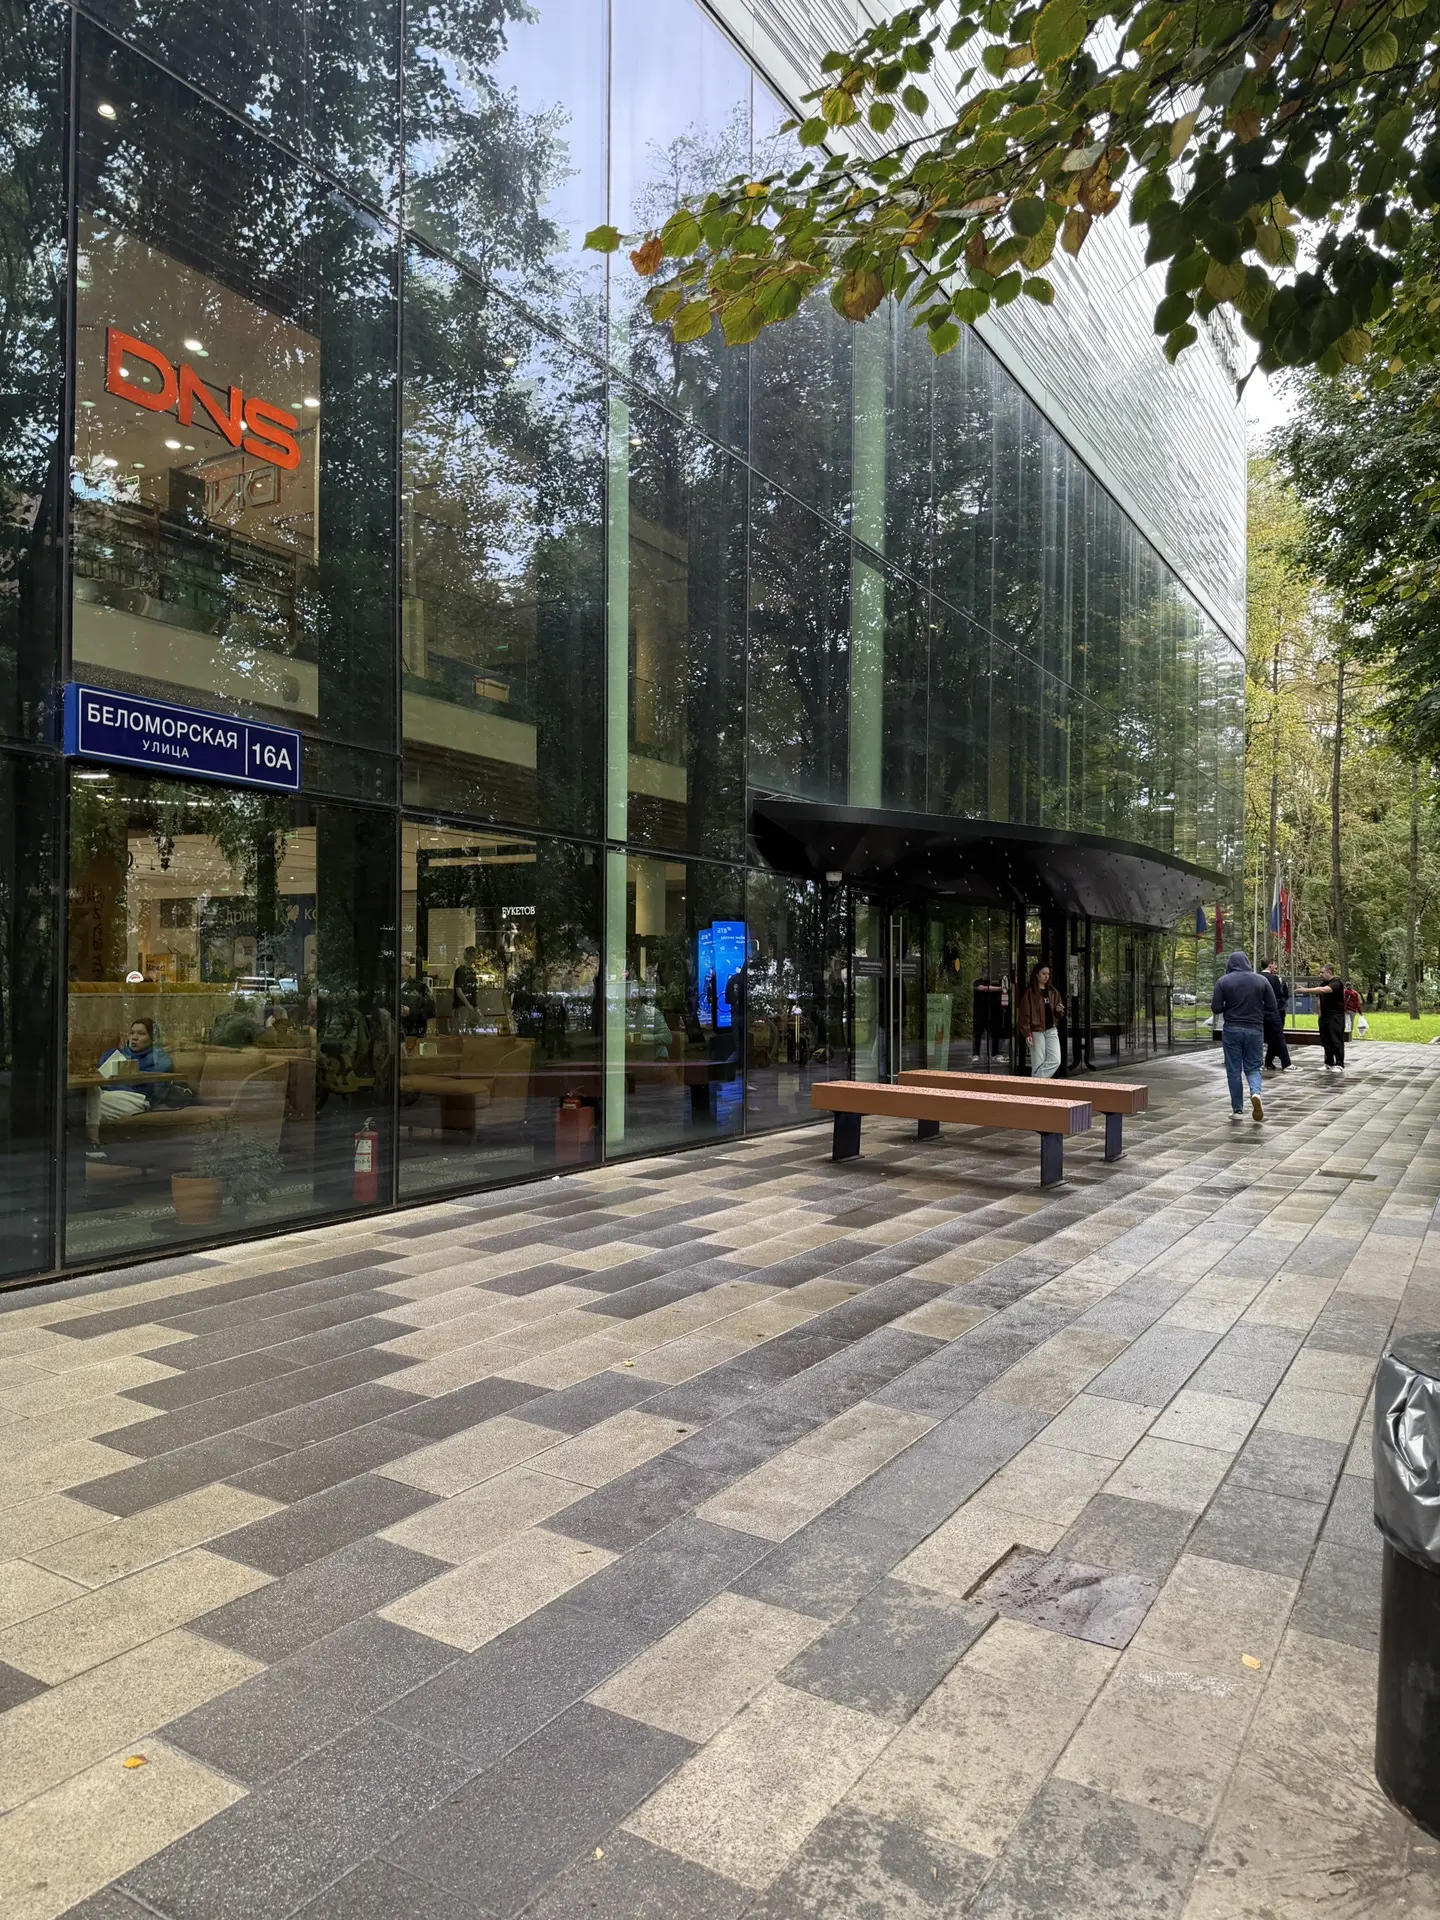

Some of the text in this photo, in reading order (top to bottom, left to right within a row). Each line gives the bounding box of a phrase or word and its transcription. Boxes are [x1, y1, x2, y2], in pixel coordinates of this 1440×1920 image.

[105, 327, 300, 470] DNS
[87, 703, 238, 749] БЕЛОМОРСКАЯ
[142, 740, 190, 758] УЛИЦА
[501, 906, 536, 916] БУКЕТОВ
